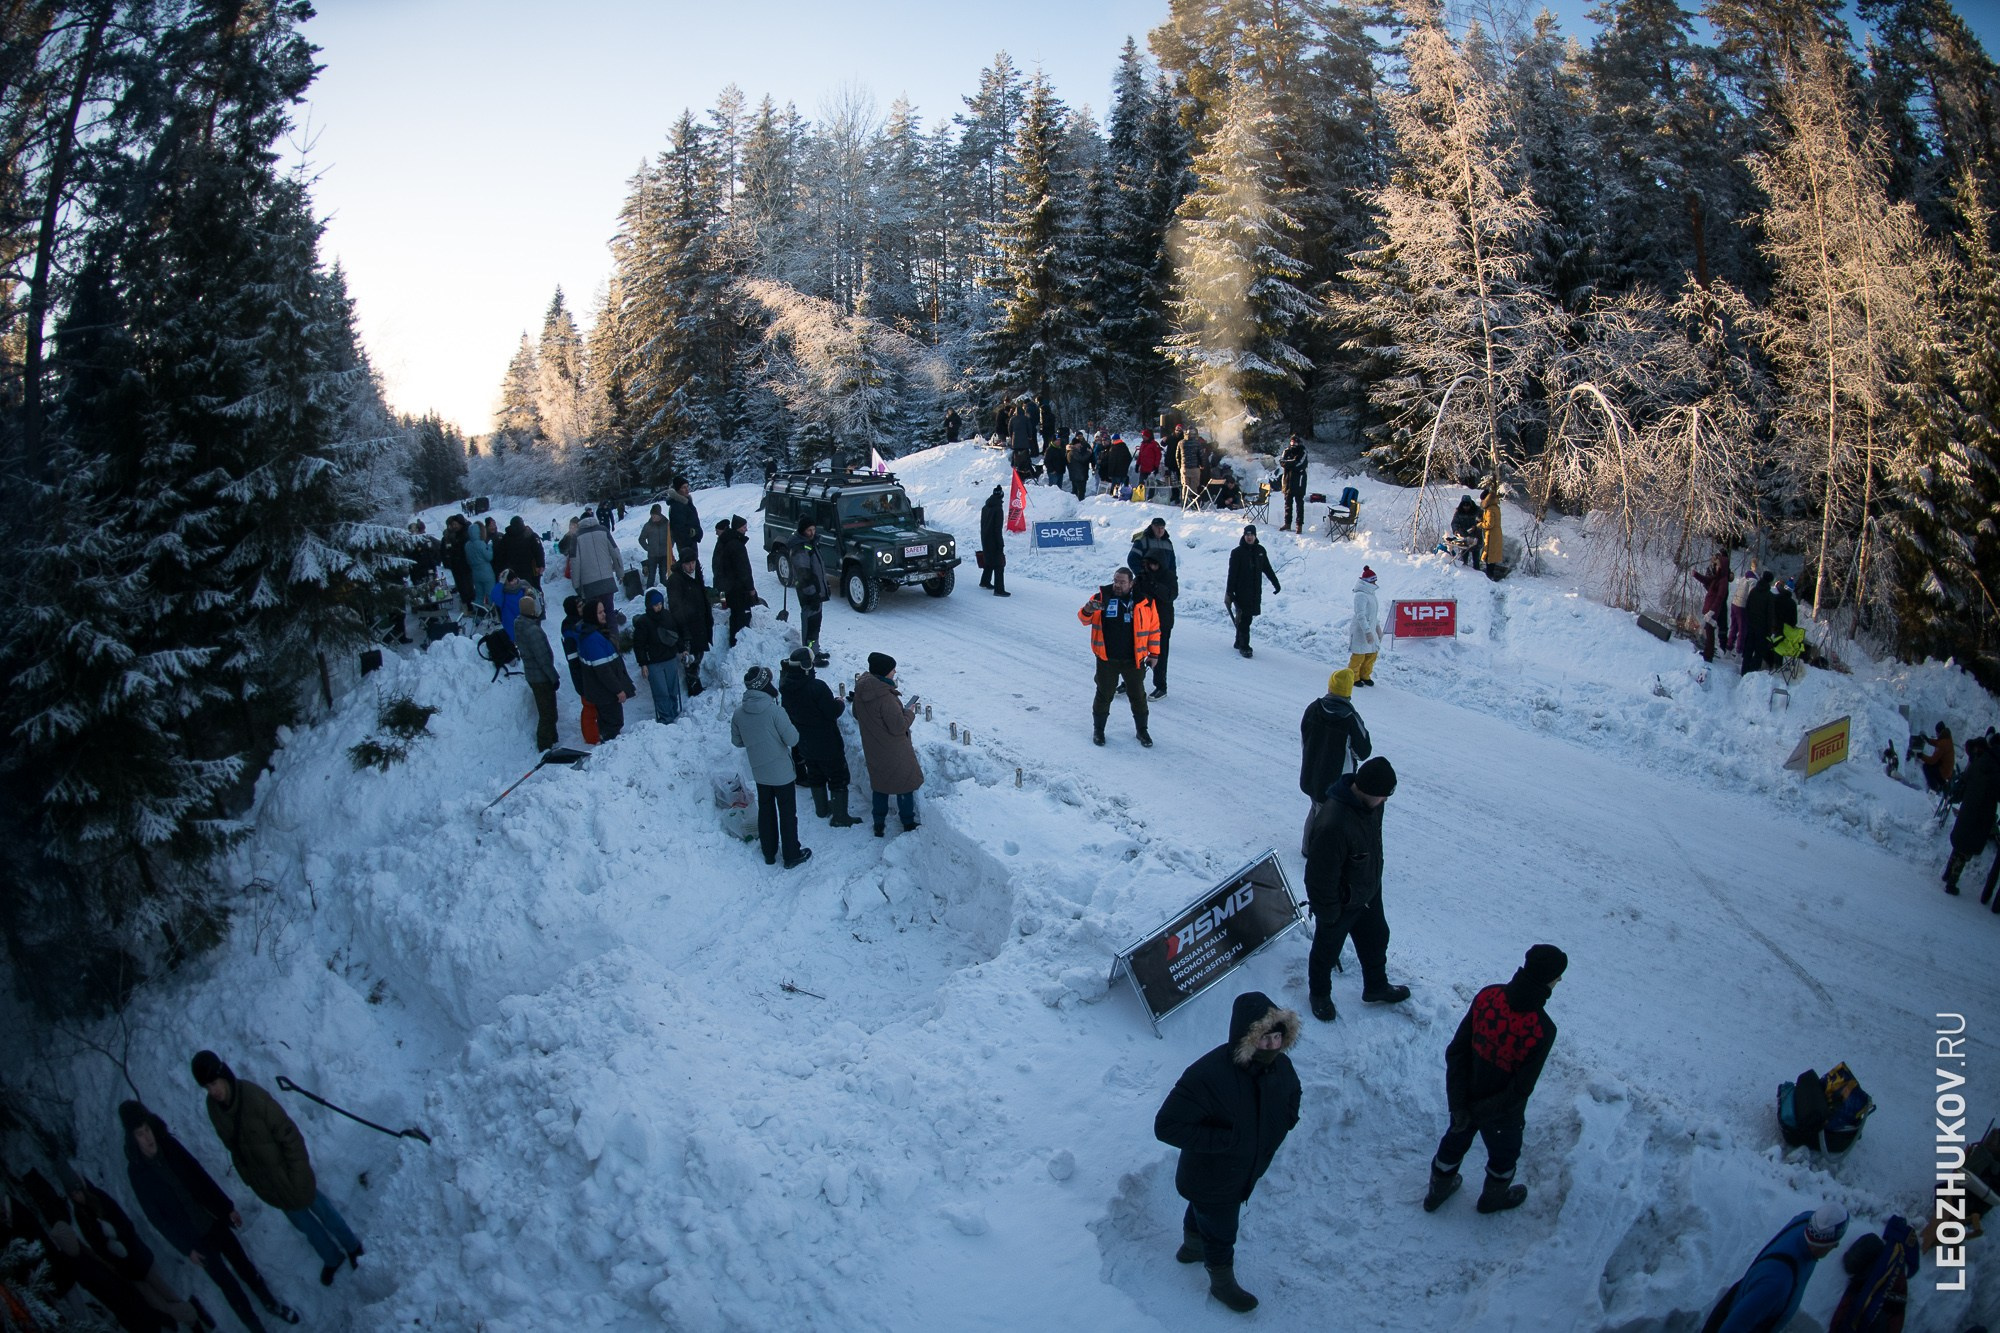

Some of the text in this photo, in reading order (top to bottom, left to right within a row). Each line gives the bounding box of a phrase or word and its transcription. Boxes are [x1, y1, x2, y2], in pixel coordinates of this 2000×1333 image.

[905, 545, 926, 554] SAFETY
[1811, 732, 1845, 763] PIRELLI
[1174, 881, 1254, 955] ASMG
[1168, 928, 1228, 974] RUSSIAN RALLY
[1172, 948, 1217, 982] PROMOTER
[1177, 942, 1244, 992] www.asmg.ru
